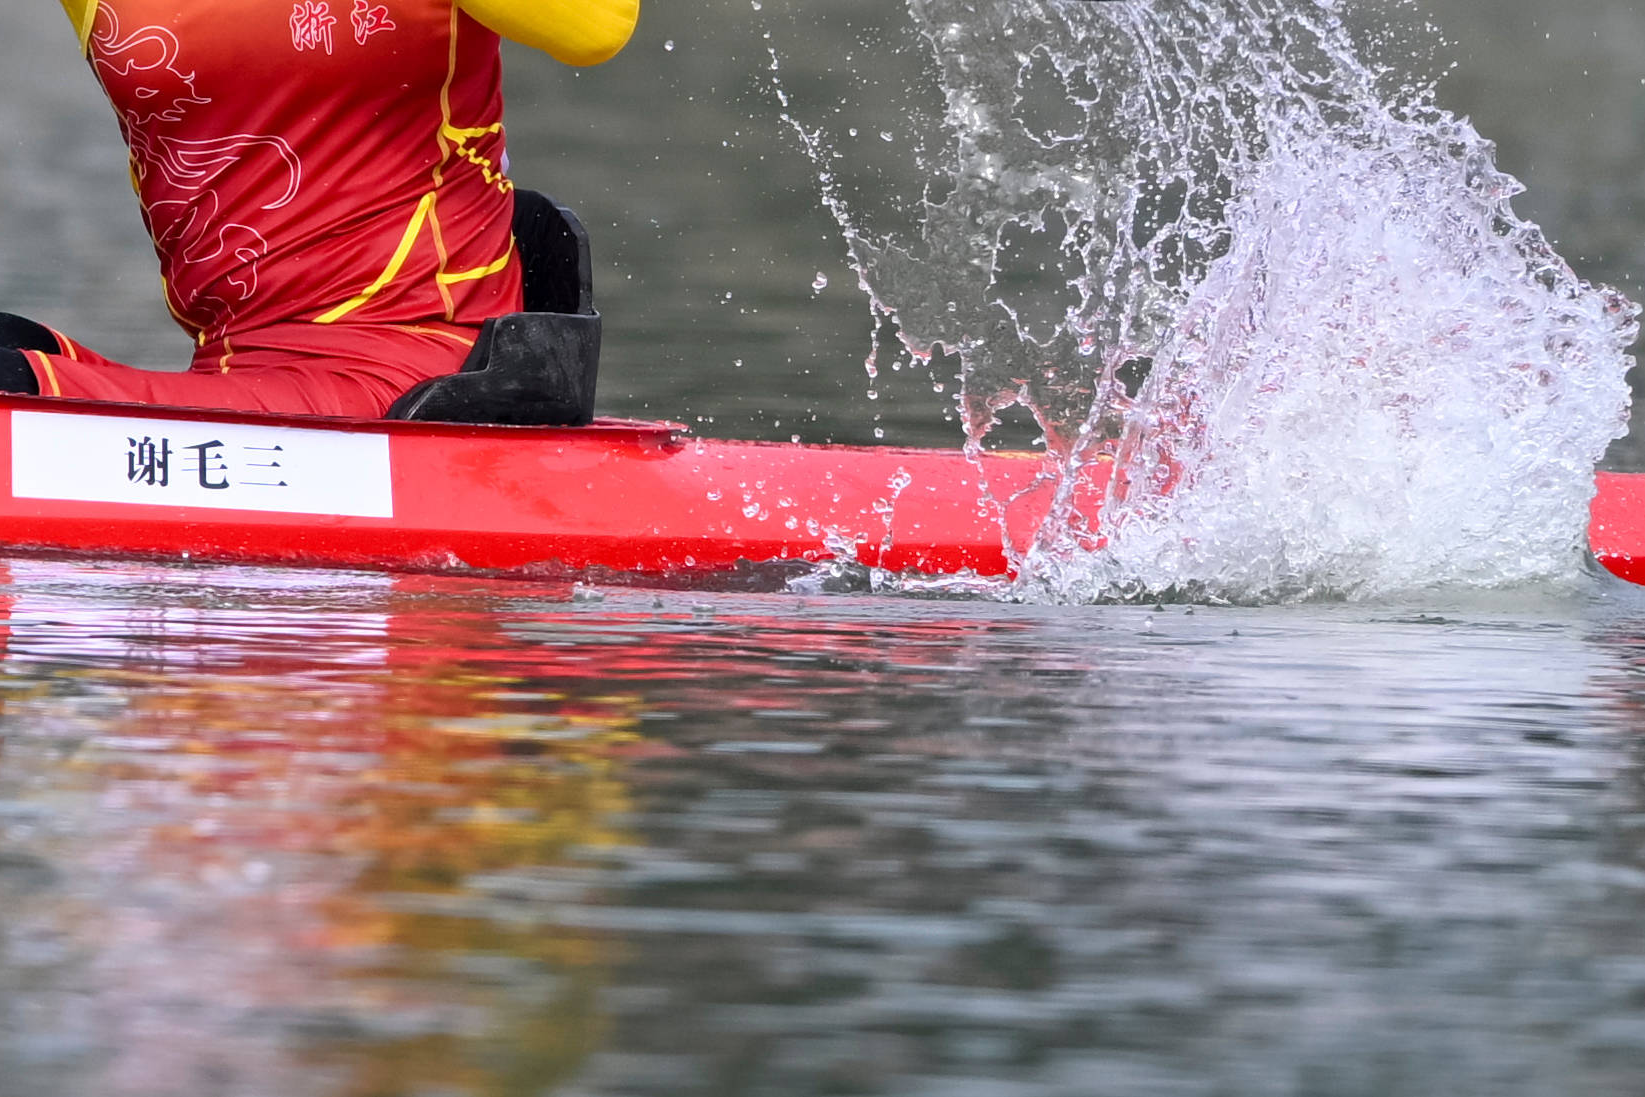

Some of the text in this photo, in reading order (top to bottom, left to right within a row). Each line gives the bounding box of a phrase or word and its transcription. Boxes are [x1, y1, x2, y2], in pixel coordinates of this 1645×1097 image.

[290, 0, 396, 55] 浙江
[124, 436, 288, 490] 谢毛三
